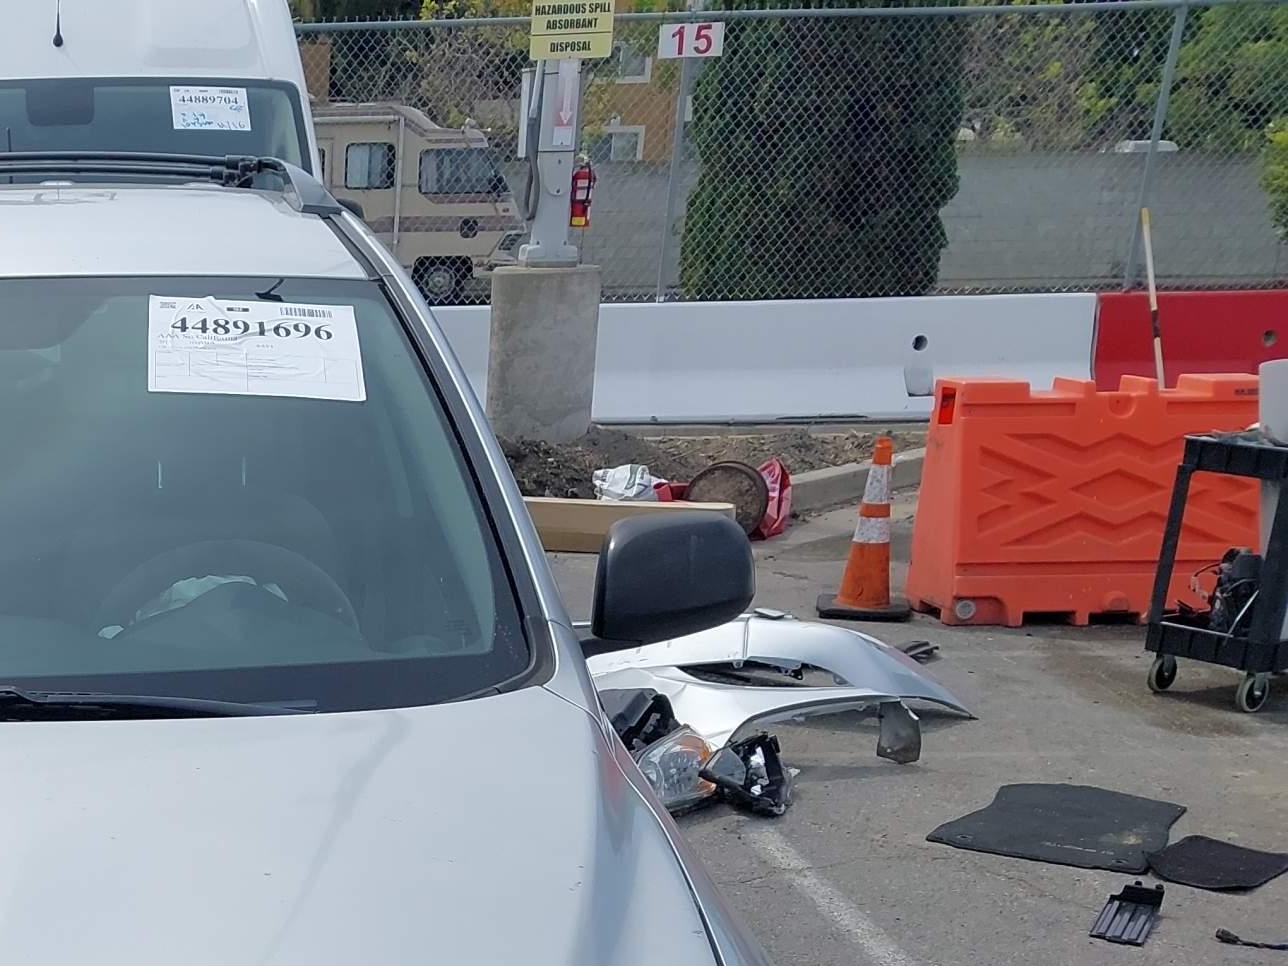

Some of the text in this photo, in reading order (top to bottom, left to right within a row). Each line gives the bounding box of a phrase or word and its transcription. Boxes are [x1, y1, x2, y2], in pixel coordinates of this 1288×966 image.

[534, 1, 611, 16] HAZARDOUS SPILL
[546, 17, 598, 30] ABSORBANT
[549, 40, 592, 53] DISPOSAL
[671, 24, 713, 56] 15
[178, 95, 239, 105] 44889704
[170, 316, 334, 341] 44891696
